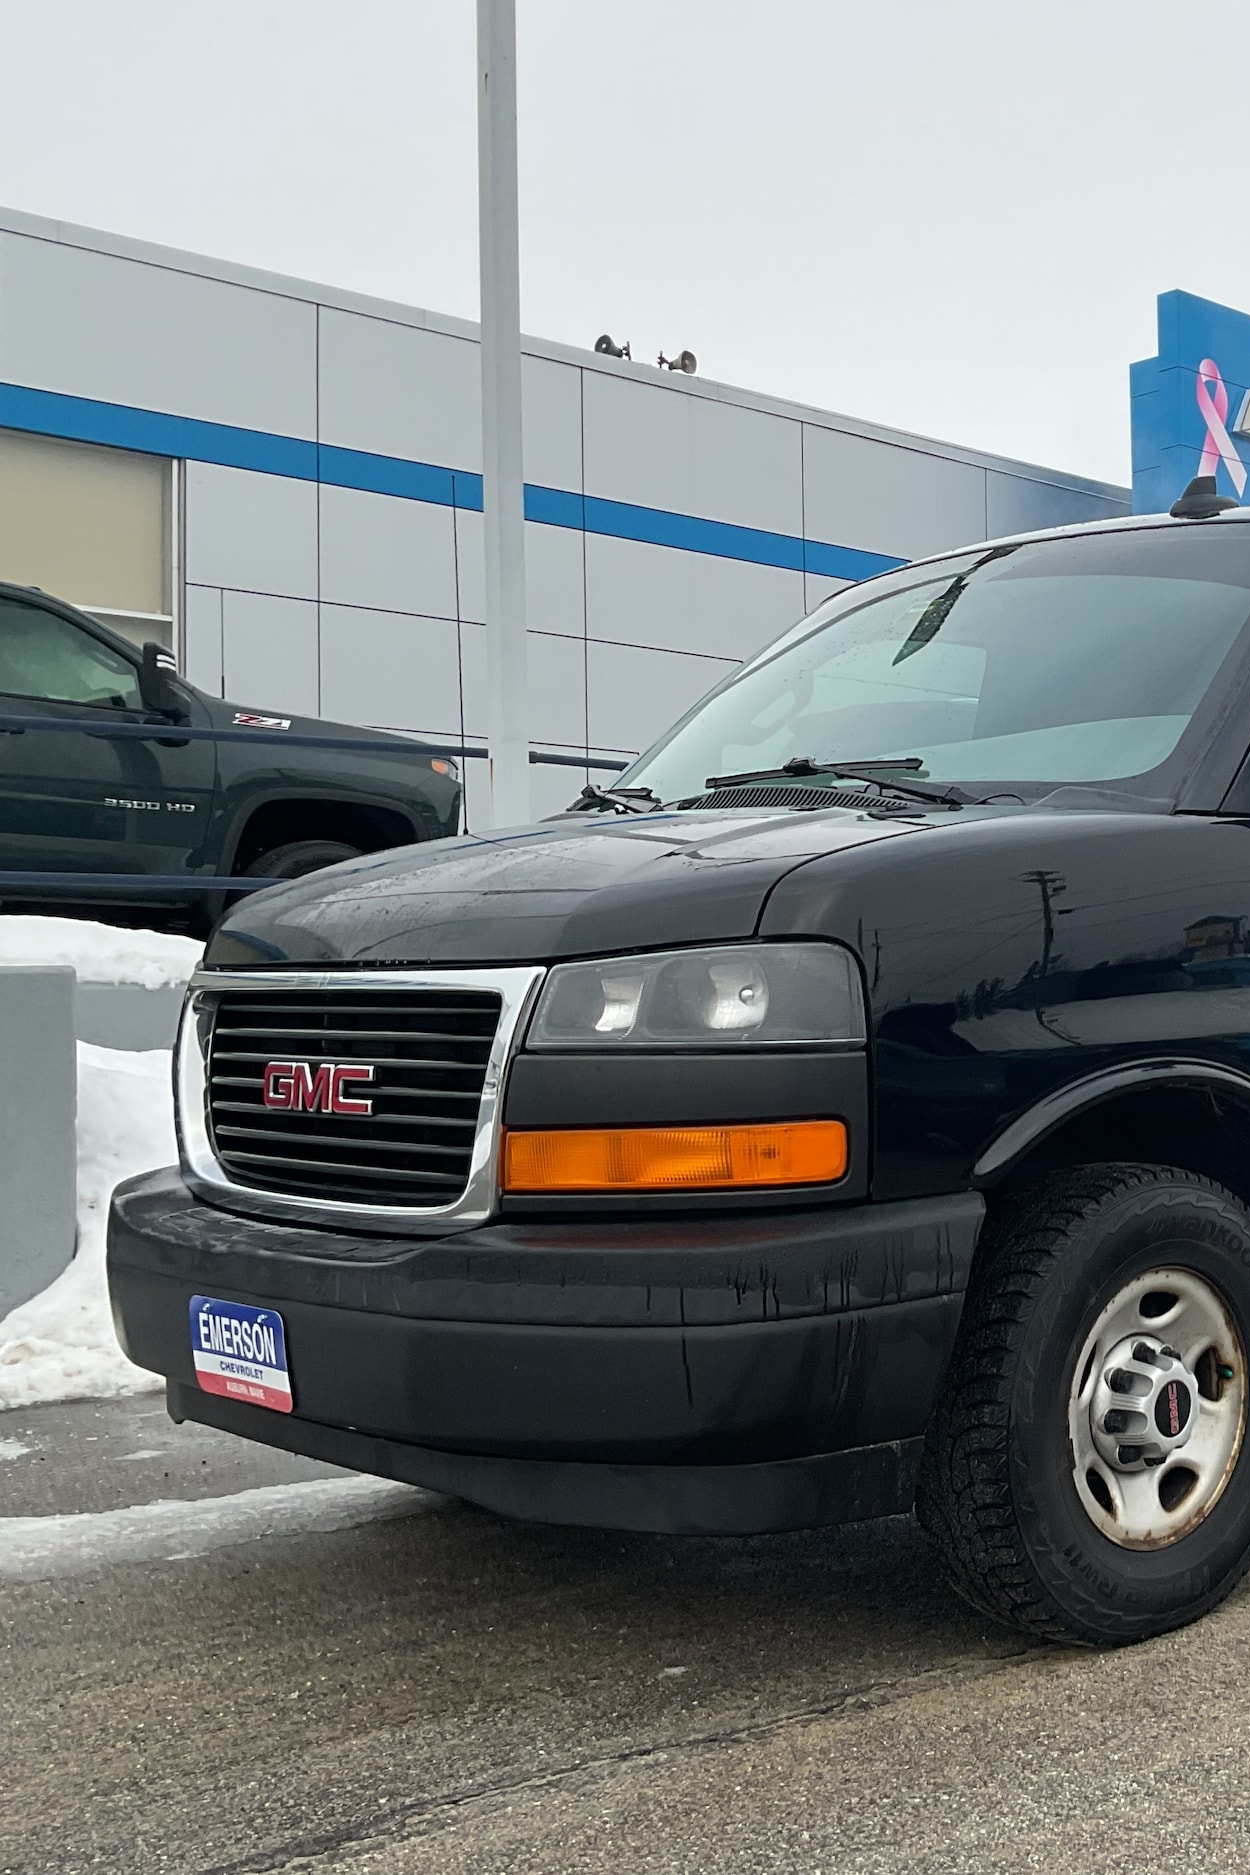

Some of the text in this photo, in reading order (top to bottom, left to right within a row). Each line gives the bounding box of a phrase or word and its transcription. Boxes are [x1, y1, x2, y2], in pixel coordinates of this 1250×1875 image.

[232, 712, 291, 731] Z71
[166, 802, 196, 813] HD
[264, 1061, 375, 1115] GMC
[198, 1312, 277, 1365] EMERSON
[219, 1360, 264, 1381] CHEVROLET
[1167, 1382, 1180, 1435] GMC
